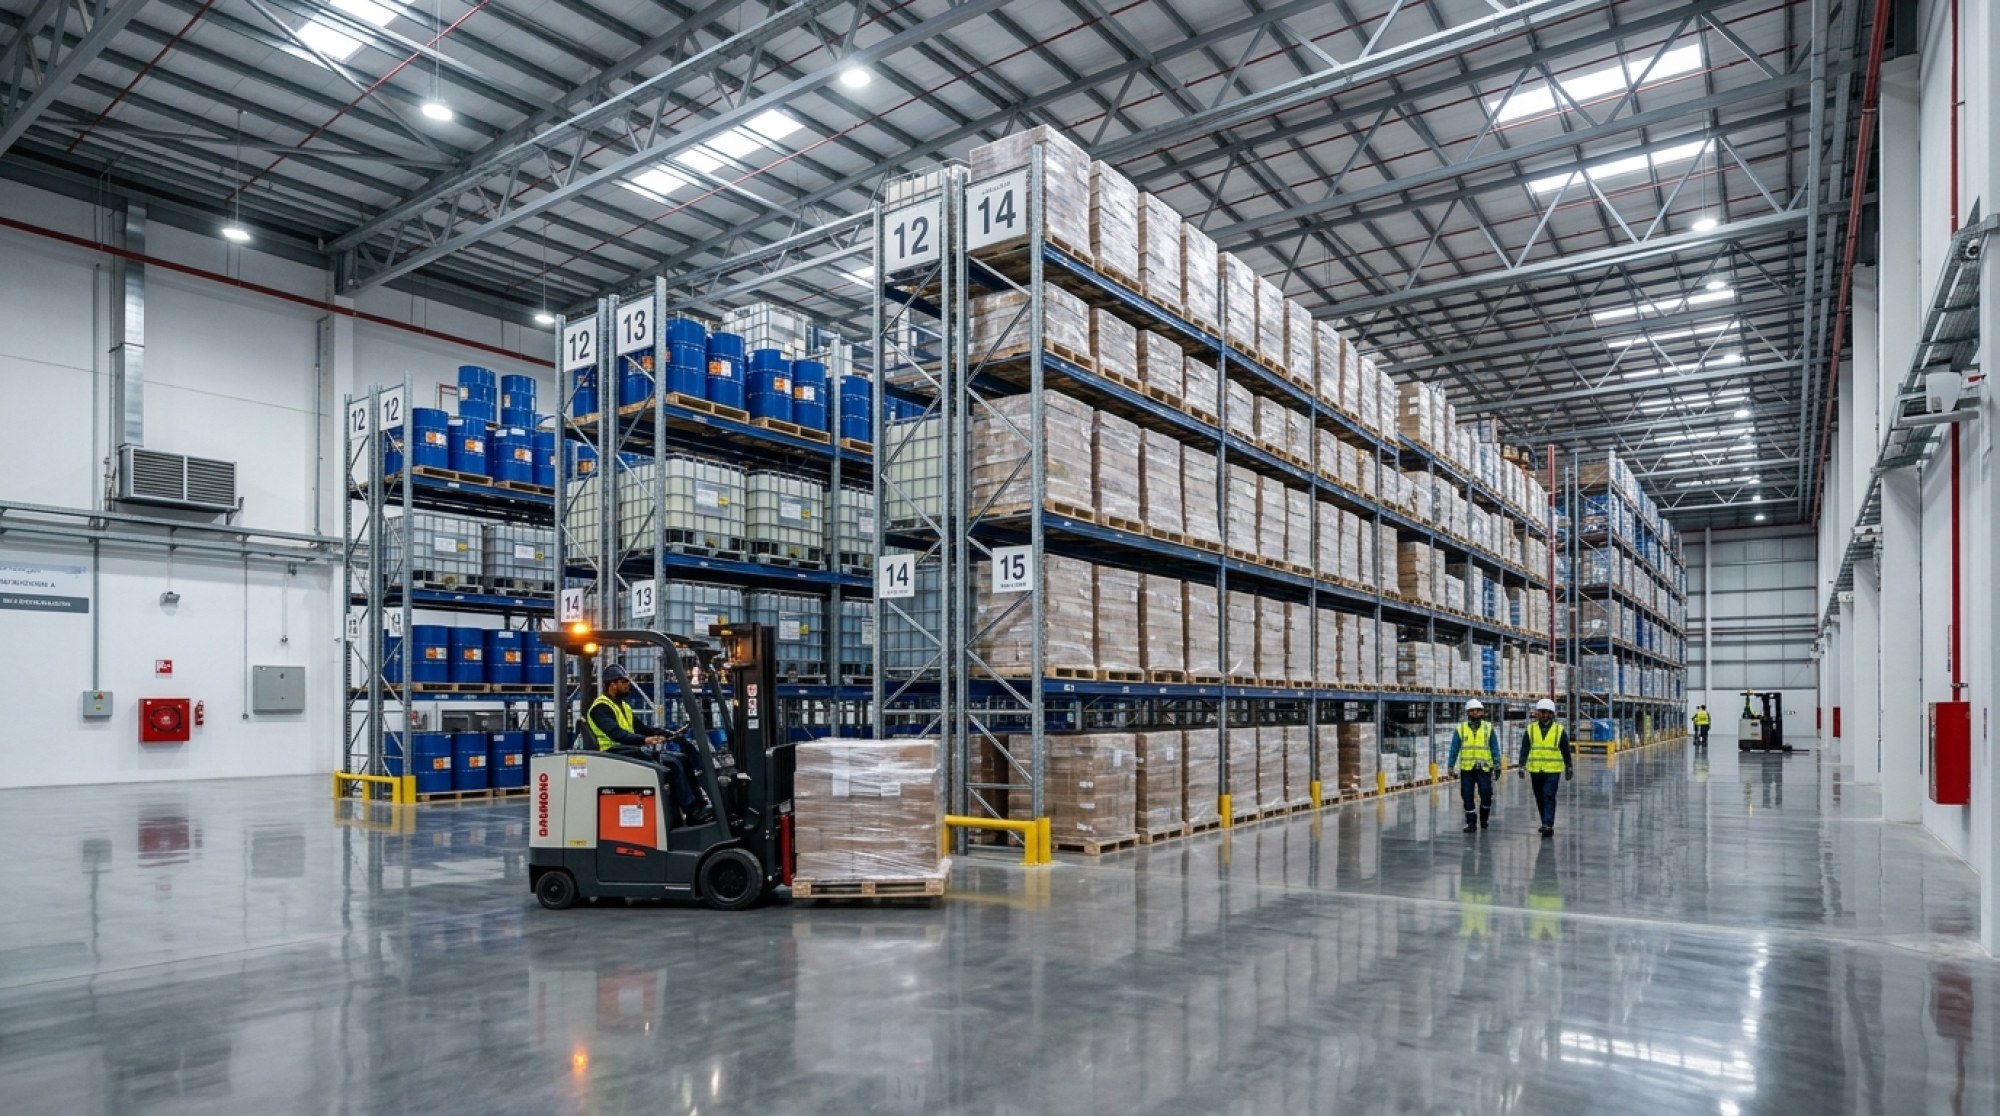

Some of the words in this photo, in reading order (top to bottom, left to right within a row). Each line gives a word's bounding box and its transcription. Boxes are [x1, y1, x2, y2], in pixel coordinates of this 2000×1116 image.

[977, 189, 1017, 235] 14
[893, 216, 929, 260] 12
[623, 310, 646, 344] 13
[569, 330, 590, 362] 12
[351, 408, 366, 433] 12
[383, 397, 399, 422] 12
[886, 562, 909, 587] 14
[1000, 554, 1026, 581] 15
[565, 595, 579, 613] 14
[636, 586, 652, 607] 13
